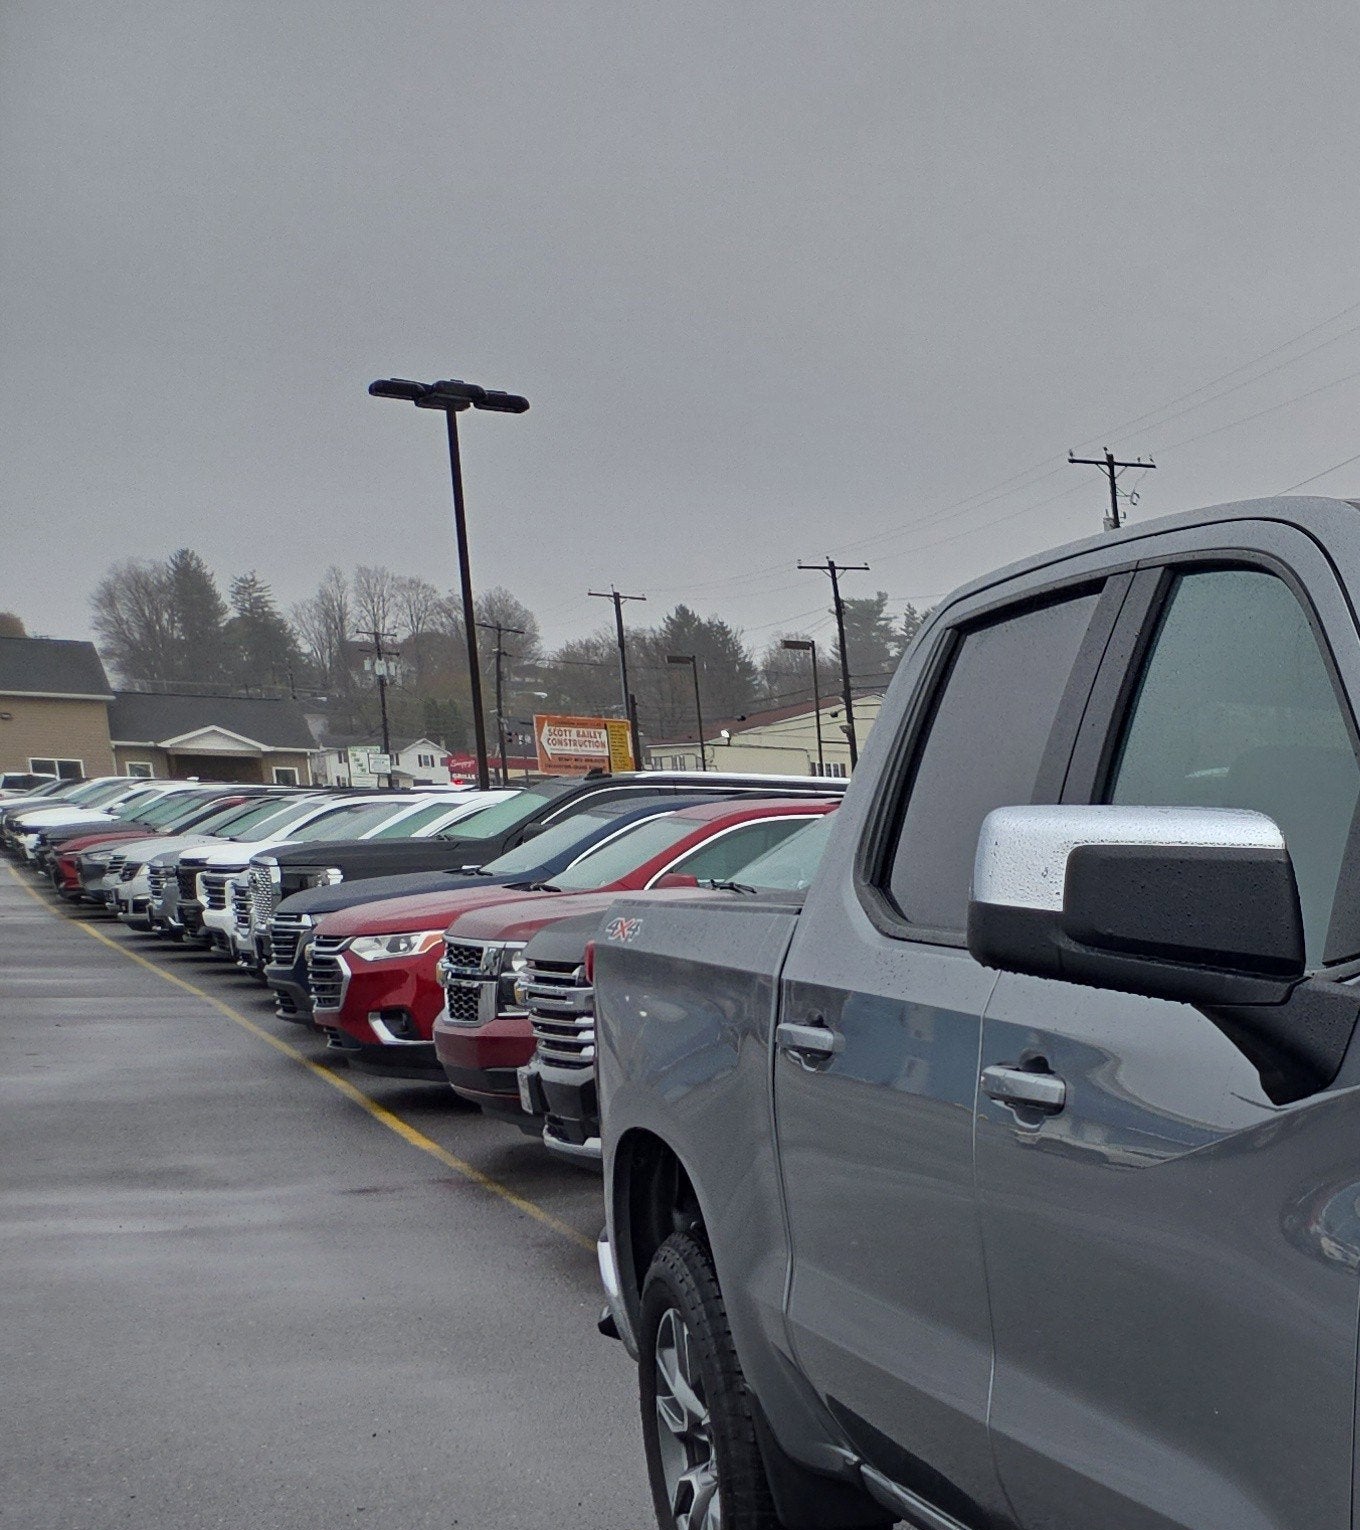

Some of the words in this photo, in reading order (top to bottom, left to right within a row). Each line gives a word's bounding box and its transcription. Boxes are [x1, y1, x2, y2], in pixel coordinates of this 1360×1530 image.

[547, 728, 573, 738] SCOTT
[576, 729, 603, 739] BAILEY
[546, 737, 606, 749] CONSTRUCTION
